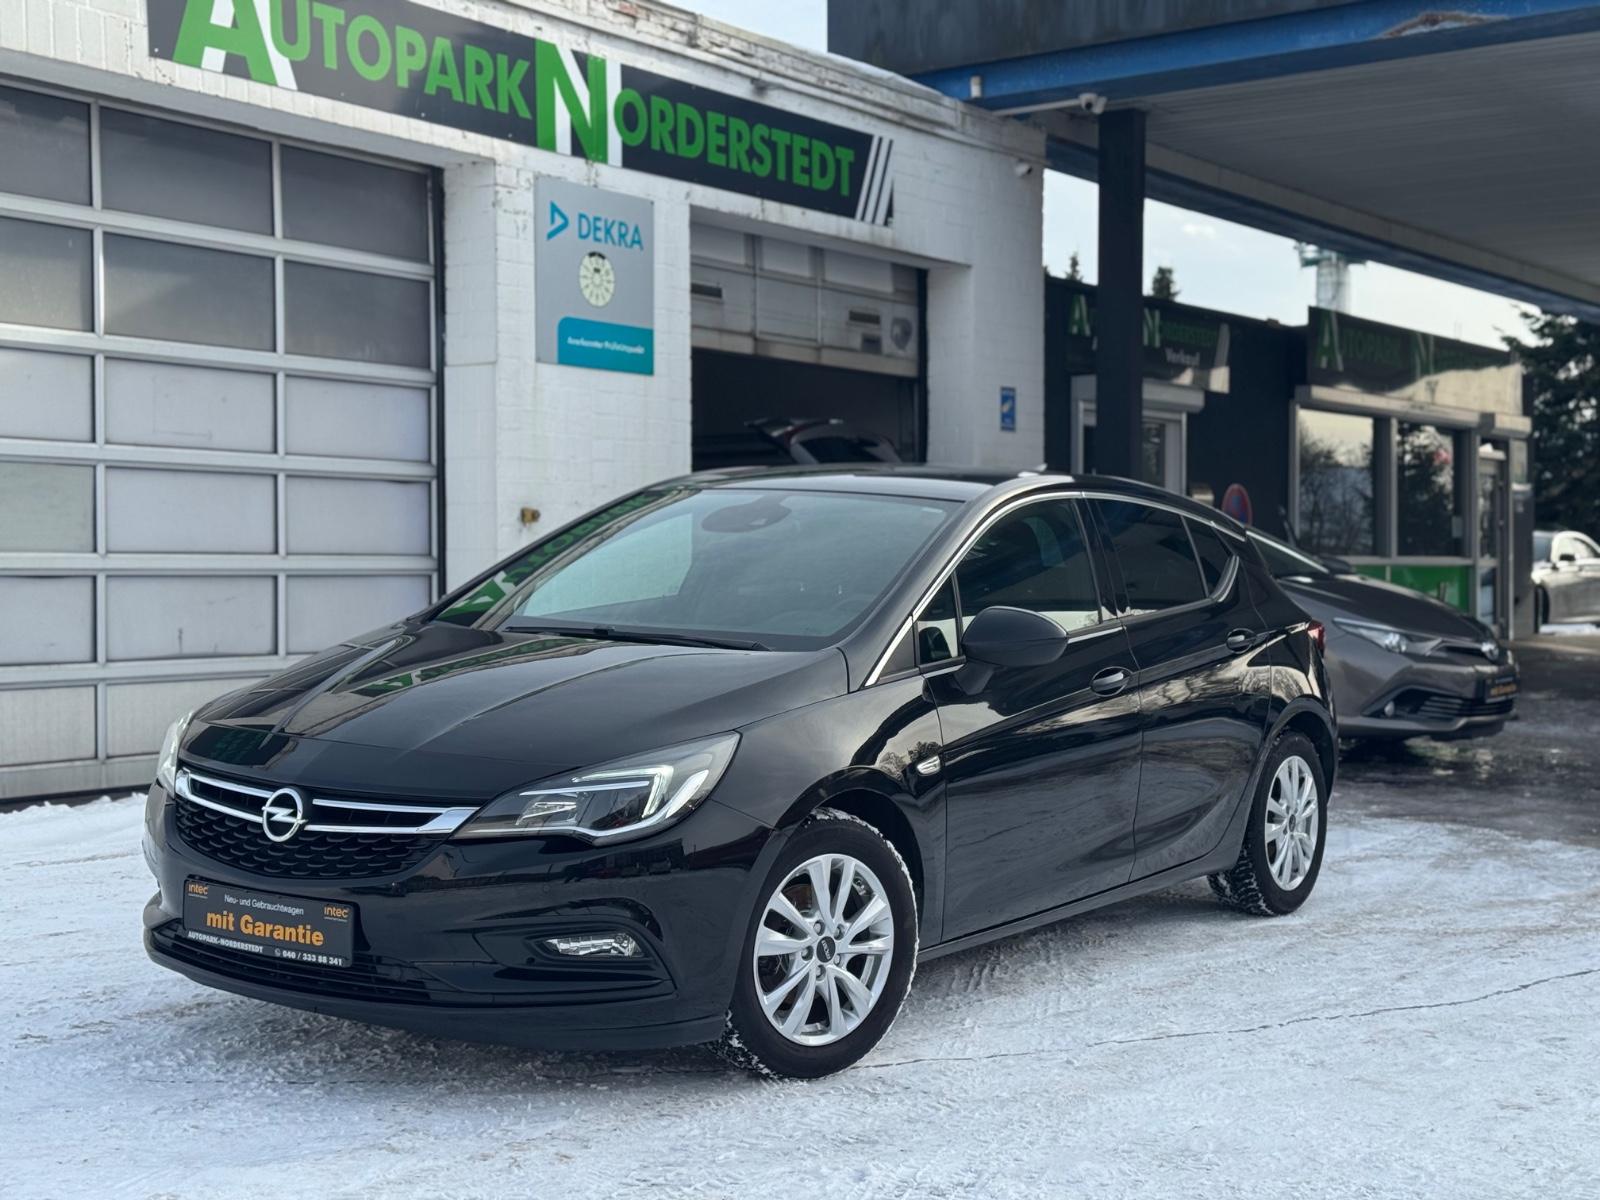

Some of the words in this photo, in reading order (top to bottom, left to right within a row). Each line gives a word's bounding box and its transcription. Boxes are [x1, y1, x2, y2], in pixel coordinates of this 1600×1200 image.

[172, 0, 532, 120] AUTOPARK
[535, 38, 855, 197] NORDERSTEDT
[577, 212, 644, 251] DEKRA
[188, 883, 209, 895] intec
[224, 894, 239, 904] Neu-
[239, 898, 251, 908] und
[251, 899, 304, 916] Gebrauchtwagen
[206, 910, 235, 931] mit
[240, 914, 325, 946] Garantie
[324, 906, 349, 918] intec
[187, 930, 264, 953] AUTOPARK-NORDERSTEDT
[302, 953, 317, 963] 333
[328, 956, 343, 966] 341
